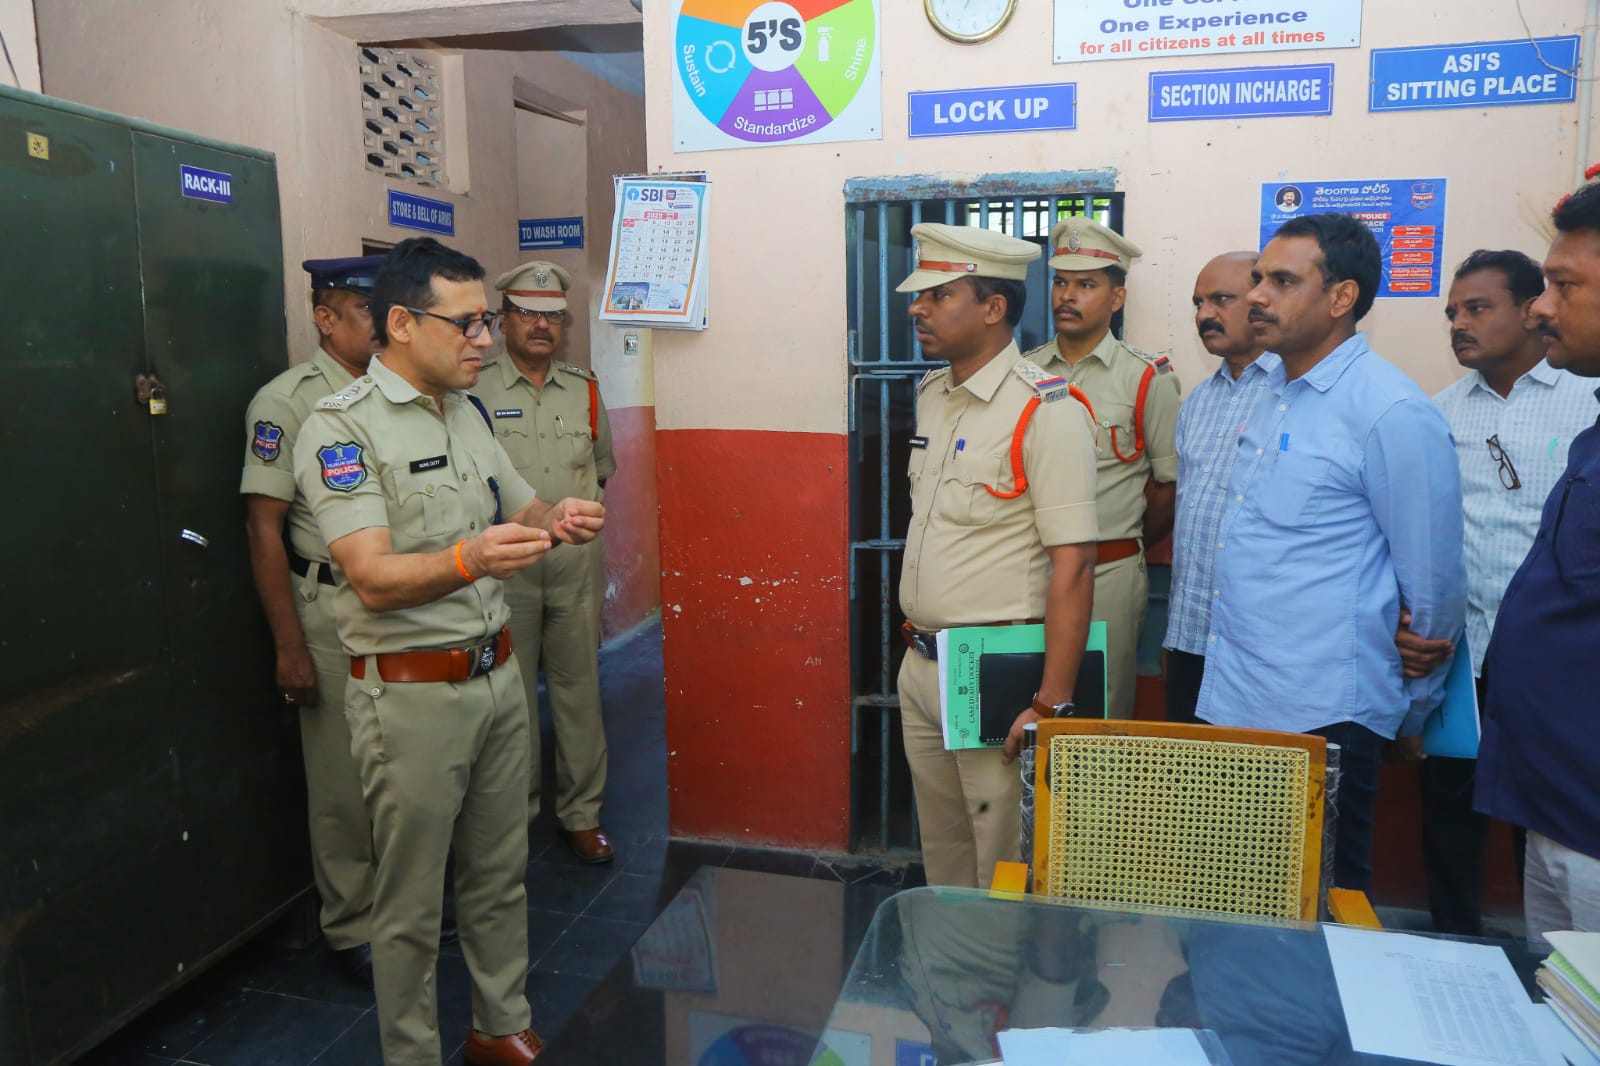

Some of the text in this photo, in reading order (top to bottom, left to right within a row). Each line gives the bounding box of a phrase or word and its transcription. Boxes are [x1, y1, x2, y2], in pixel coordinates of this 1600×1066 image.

[1100, 9, 1308, 34] One Experience
[1080, 30, 1326, 54] for all citizens at all times
[683, 44, 706, 96] Sustain
[844, 38, 866, 80] Shine
[1442, 52, 1500, 74] ASI'S
[1160, 78, 1321, 107] SECTION INCHARGE
[1387, 74, 1558, 101] SITTING PLACE
[934, 97, 1049, 124] LOCK UP
[734, 114, 816, 136] Standardize
[184, 173, 230, 196] RACK-III
[640, 188, 663, 202] SBI
[392, 200, 452, 226] STORE & BELL OF ARMS
[521, 224, 580, 240] TO WASH ROOM
[327, 464, 360, 477] POLICE
